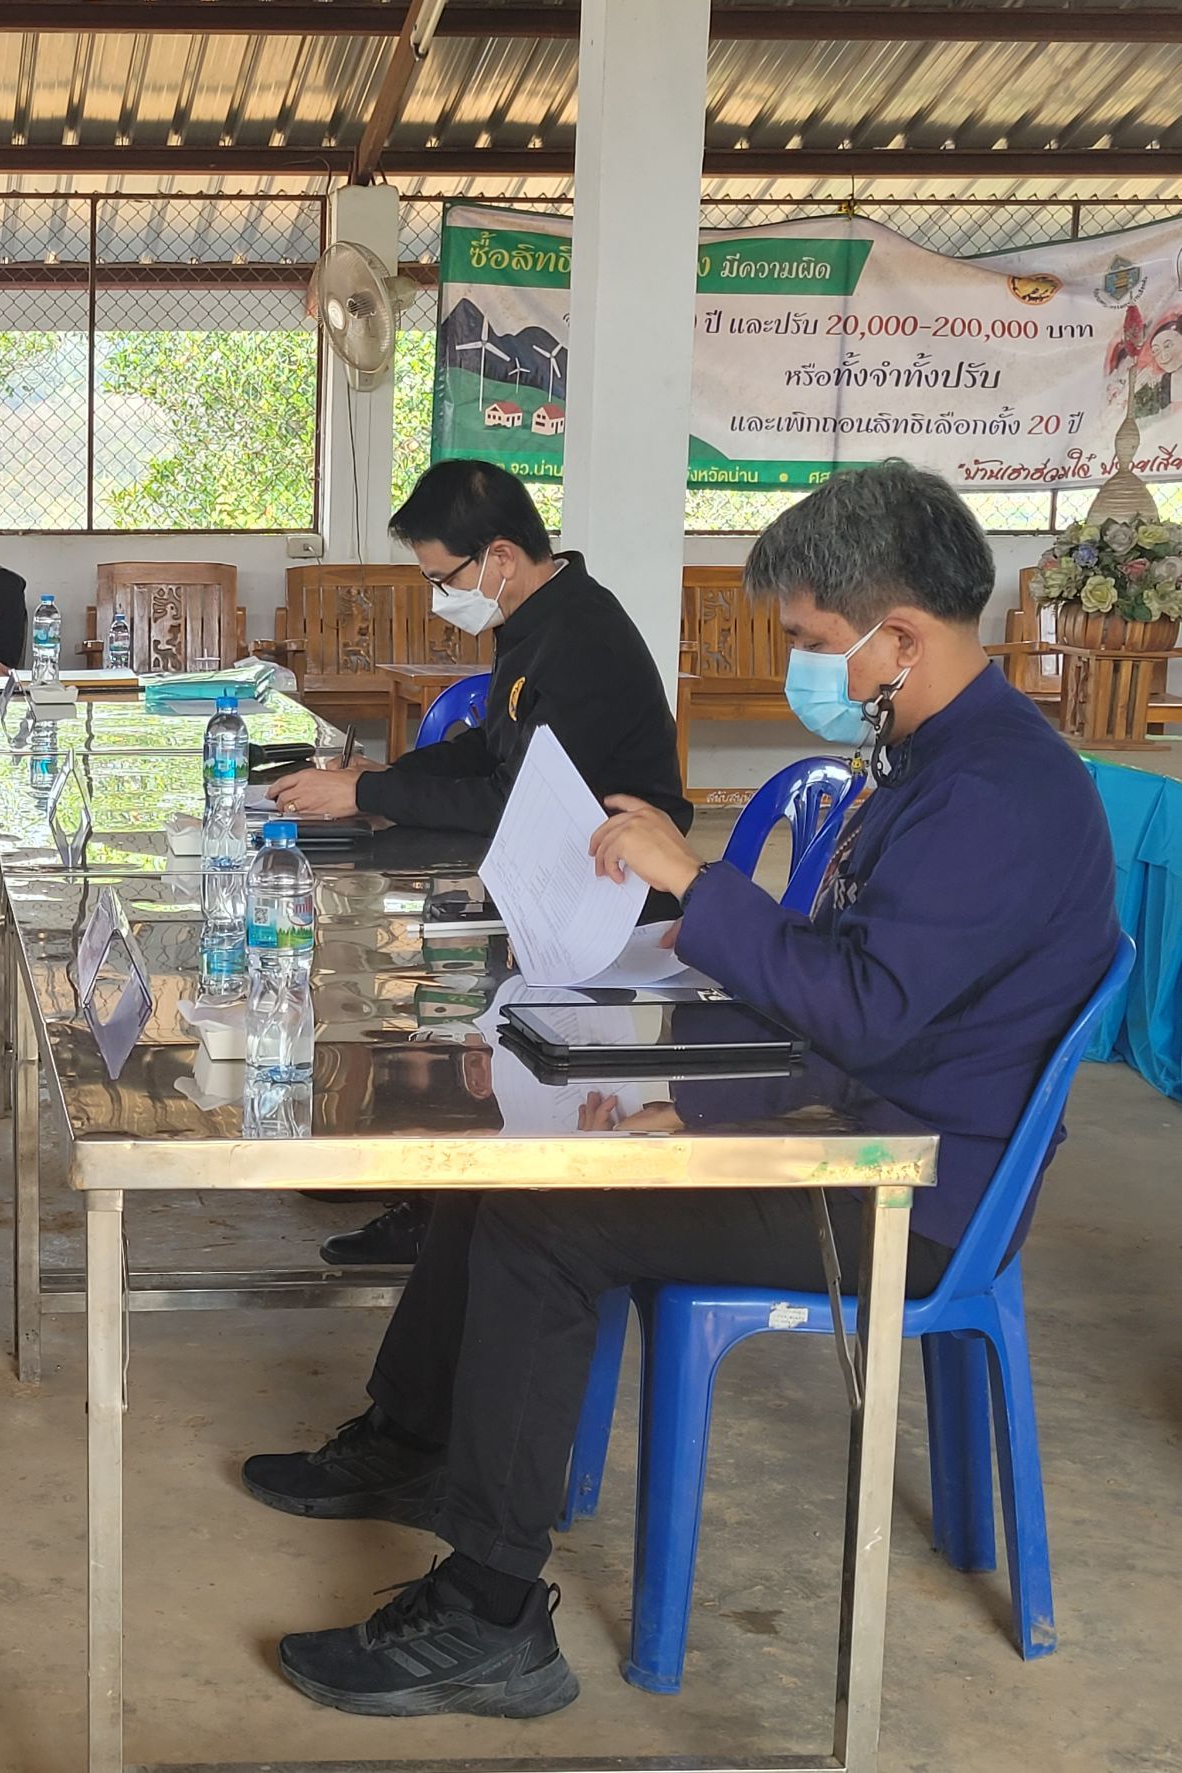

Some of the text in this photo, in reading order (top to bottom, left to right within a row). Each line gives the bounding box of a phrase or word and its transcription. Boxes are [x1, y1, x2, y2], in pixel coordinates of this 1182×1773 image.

[720, 252, 831, 279] มีความผิด
[729, 311, 818, 335] และปรับ
[1046, 320, 1095, 339] บาท
[1027, 413, 1061, 435] 20
